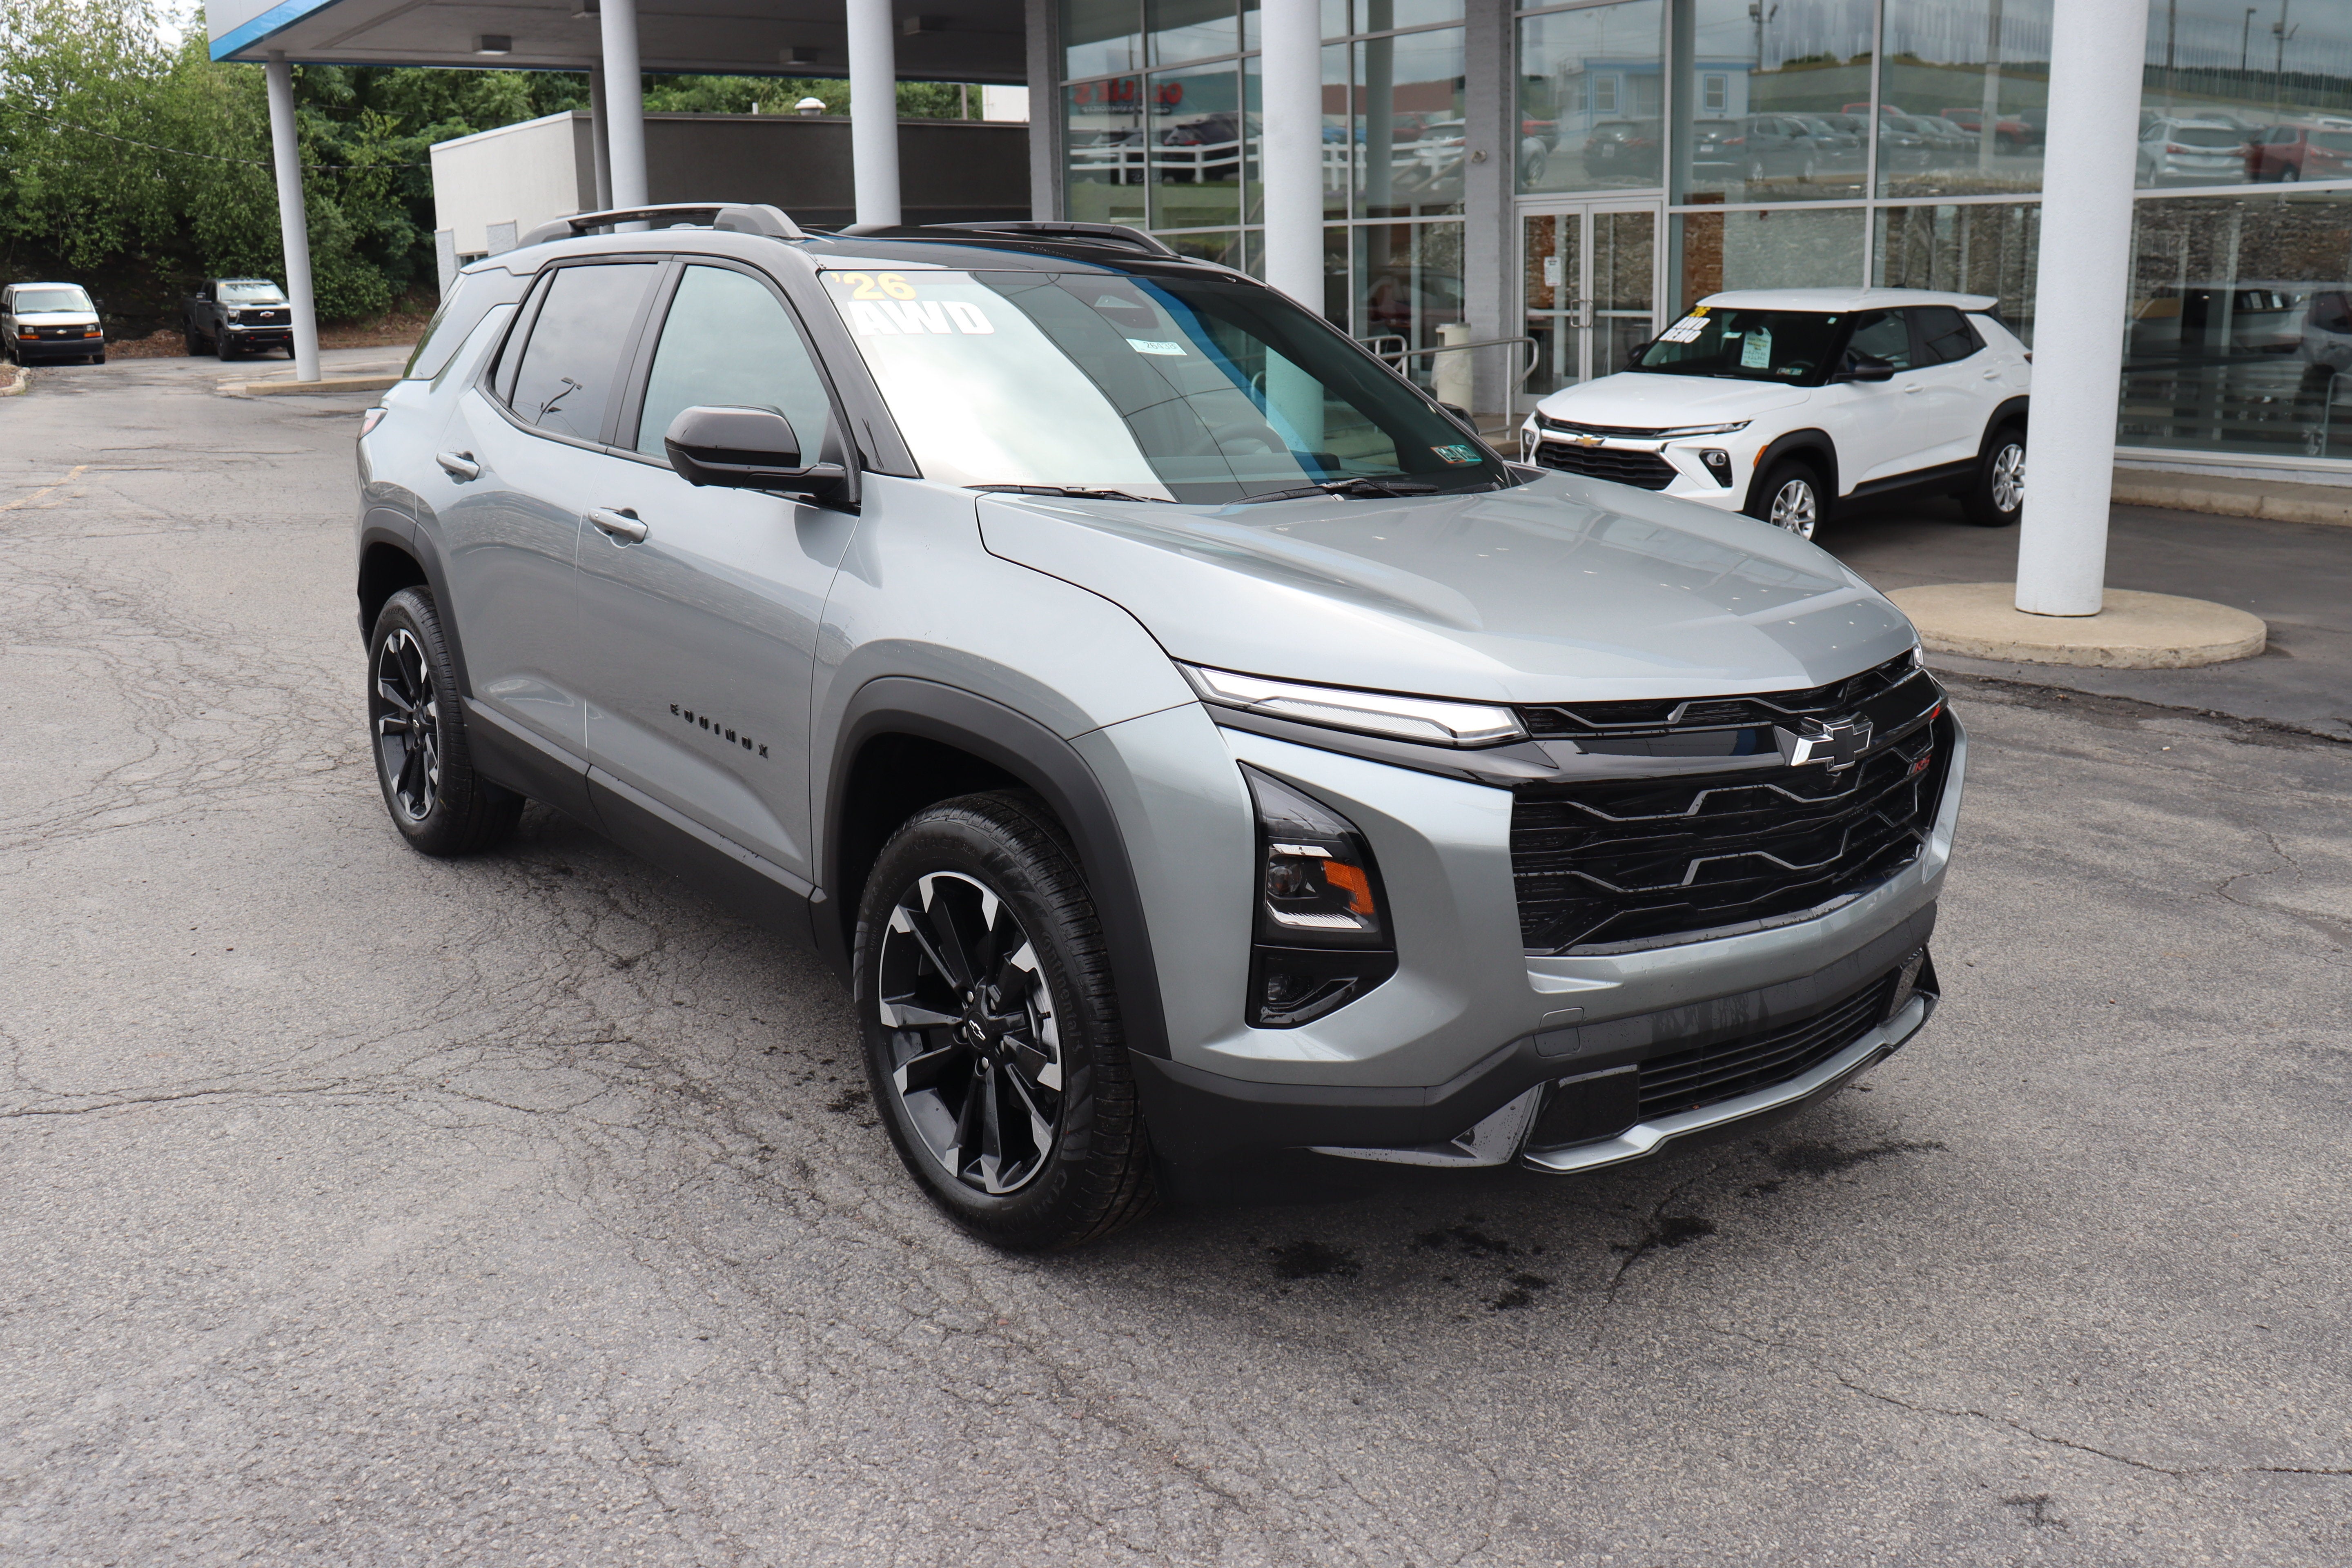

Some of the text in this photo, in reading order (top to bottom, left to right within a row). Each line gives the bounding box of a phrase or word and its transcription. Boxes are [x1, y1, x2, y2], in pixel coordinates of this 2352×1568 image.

[847, 301, 995, 335] AWD
[1672, 316, 1711, 330] AWD
[1659, 328, 1702, 343] DEMO
[670, 702, 768, 760] EQUINOX
[1913, 754, 1932, 774] RS
